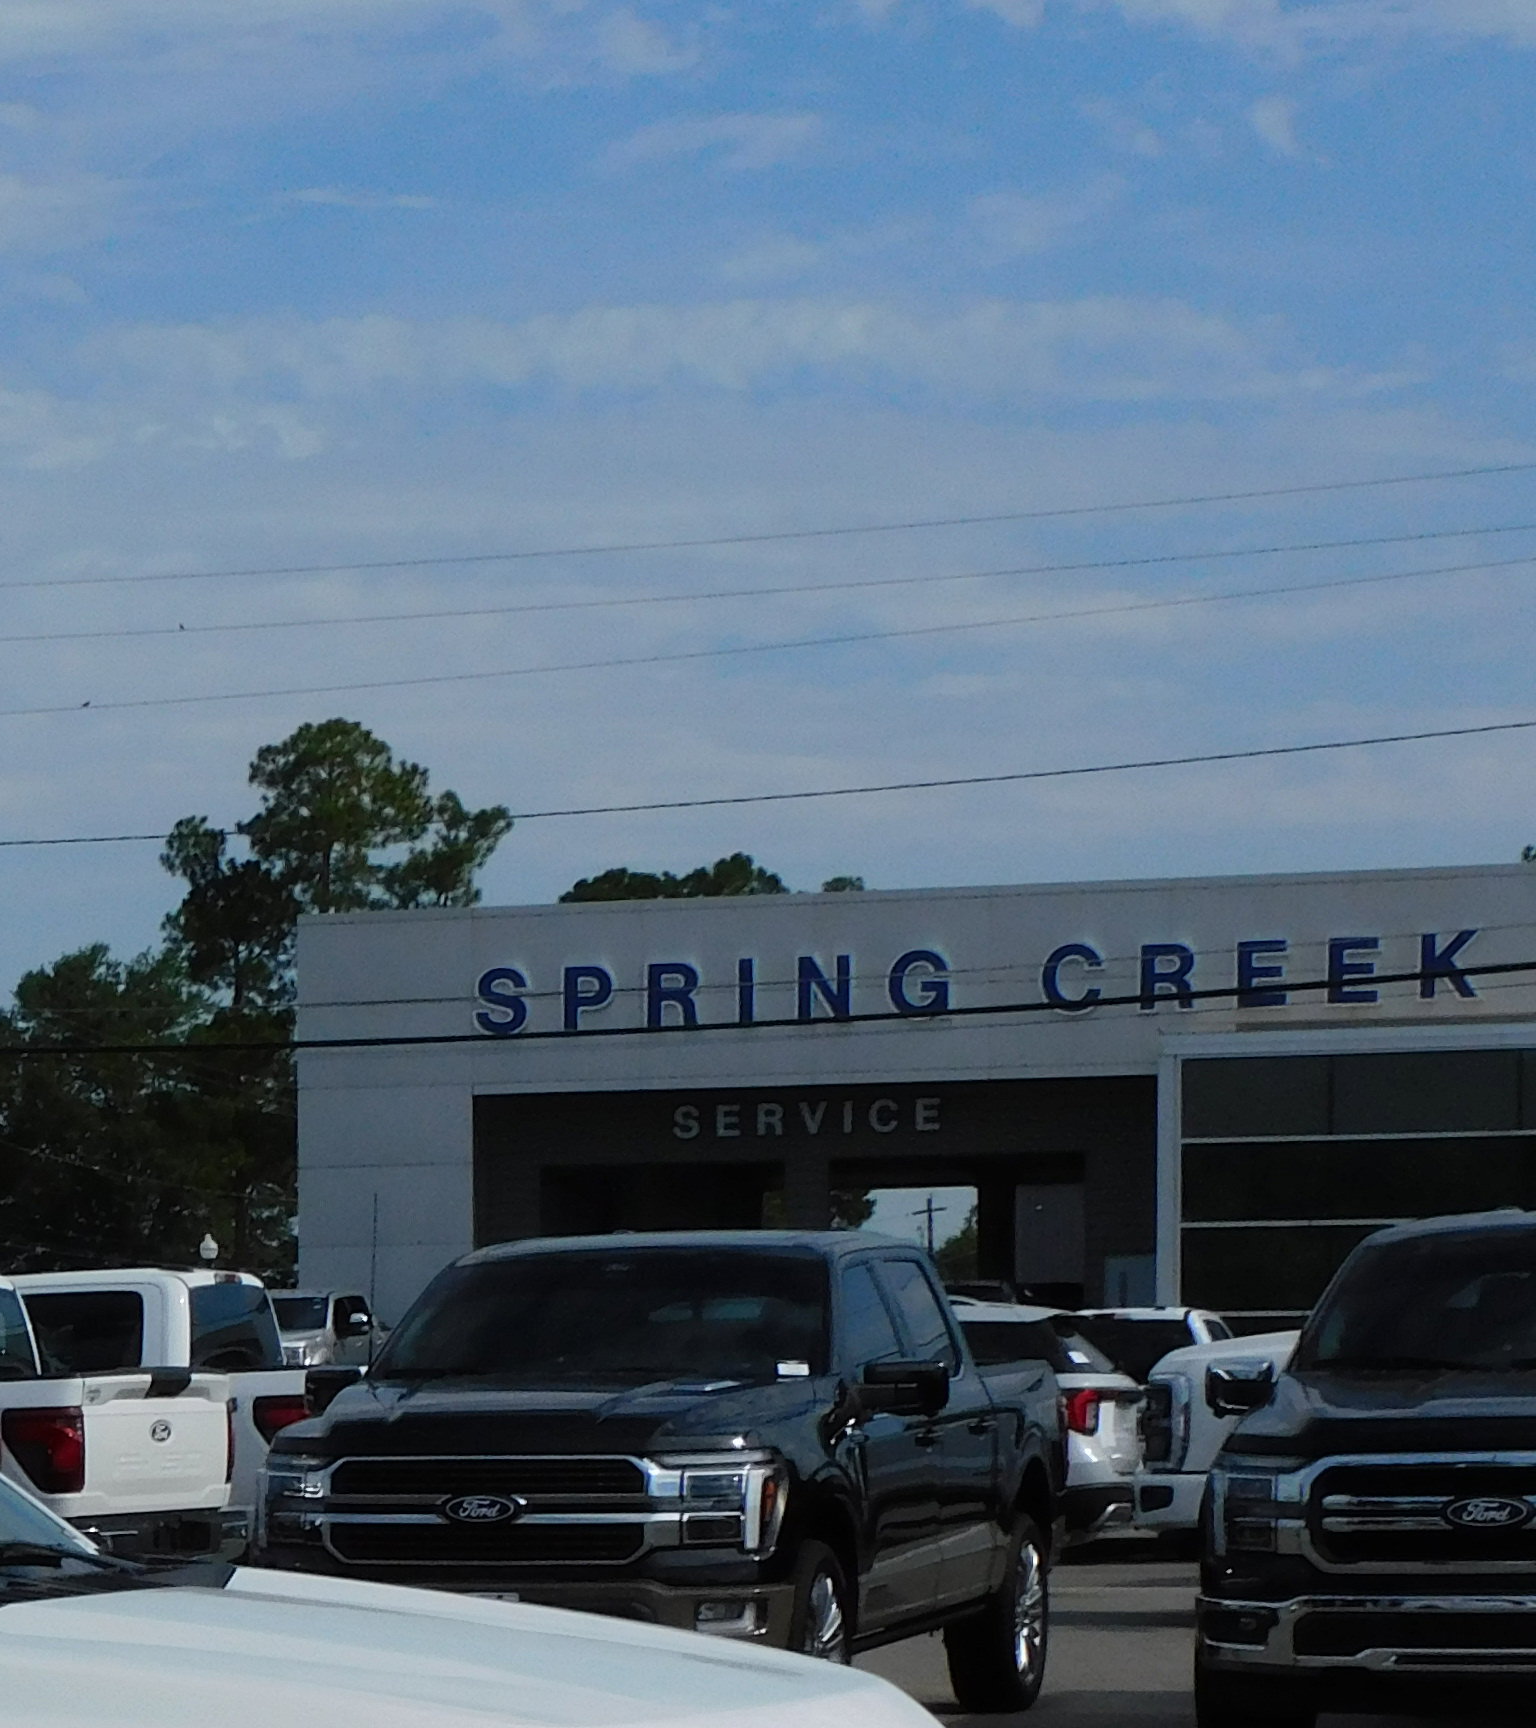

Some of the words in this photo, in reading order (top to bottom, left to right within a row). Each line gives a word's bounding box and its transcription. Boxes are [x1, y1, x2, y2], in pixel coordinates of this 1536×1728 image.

[475, 949, 950, 1035] SPRING
[1041, 929, 1479, 1010] CREEK
[672, 1098, 941, 1139] SERVICE
[1460, 1500, 1512, 1522] Ford
